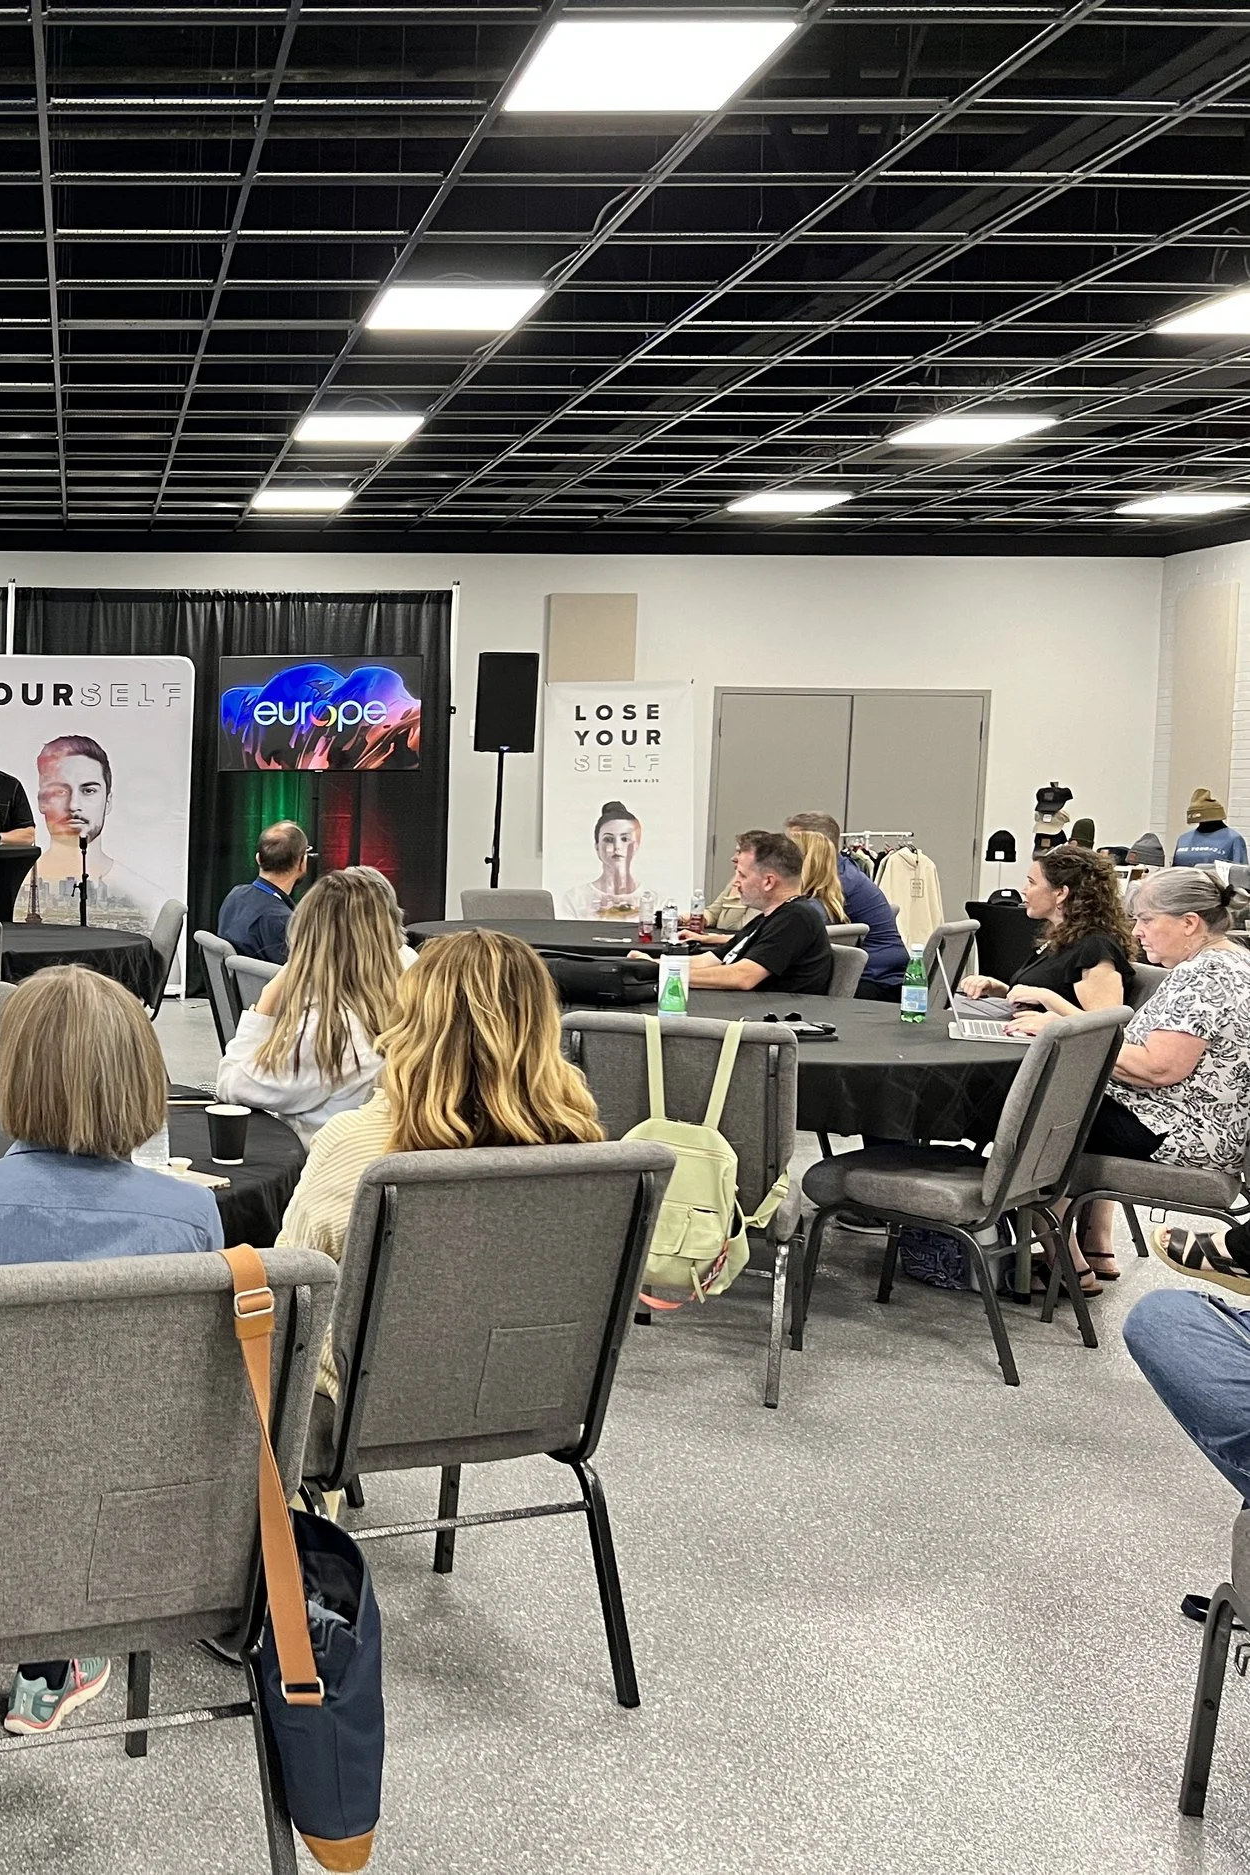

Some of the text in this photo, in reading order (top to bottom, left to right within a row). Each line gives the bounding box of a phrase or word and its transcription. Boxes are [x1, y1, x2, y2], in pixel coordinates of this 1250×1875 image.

[253, 699, 388, 732] europe
[575, 704, 660, 721] LOSE
[574, 729, 662, 746] YOUR
[574, 754, 660, 772] SELF
